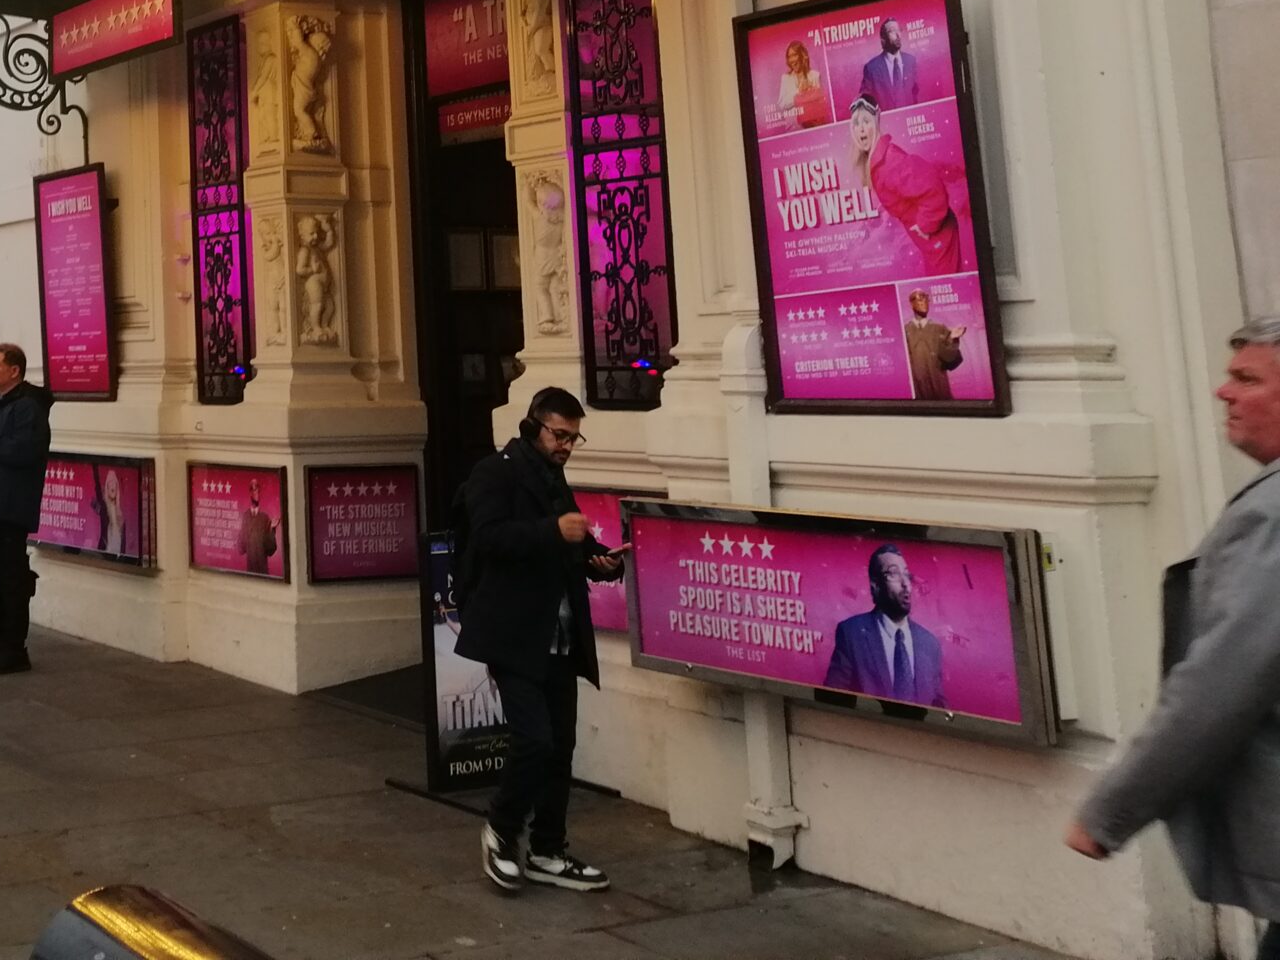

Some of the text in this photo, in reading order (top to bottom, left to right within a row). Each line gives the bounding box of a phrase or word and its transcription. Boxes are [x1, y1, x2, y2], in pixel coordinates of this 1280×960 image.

[823, 16, 880, 44] TRIUMPH”
[463, 49, 483, 65] THE
[447, 114, 455, 128] IS
[457, 106, 502, 126] GWYNETH
[908, 122, 934, 136] VICKERS
[773, 157, 838, 198] I WISH
[777, 185, 879, 232] YOU WELL
[784, 240, 797, 250] THE
[798, 235, 832, 248] GWYNETH
[818, 241, 848, 254] MUSICAL
[795, 359, 834, 373] CRITERION
[834, 356, 869, 370] THEATRE
[320, 503, 405, 520] “THE STRONGEST
[328, 520, 399, 538] NEW MUSICAL
[323, 537, 404, 556] OF THE FRINGE”
[679, 559, 801, 594] “THIS CELEBRITY
[679, 585, 806, 623] SPOOF IS A SHEER
[670, 610, 740, 642] PLEASURE
[726, 646, 767, 662] THE LIST
[442, 690, 508, 730] TiTAN
[450, 756, 505, 777] FROM 9 D
